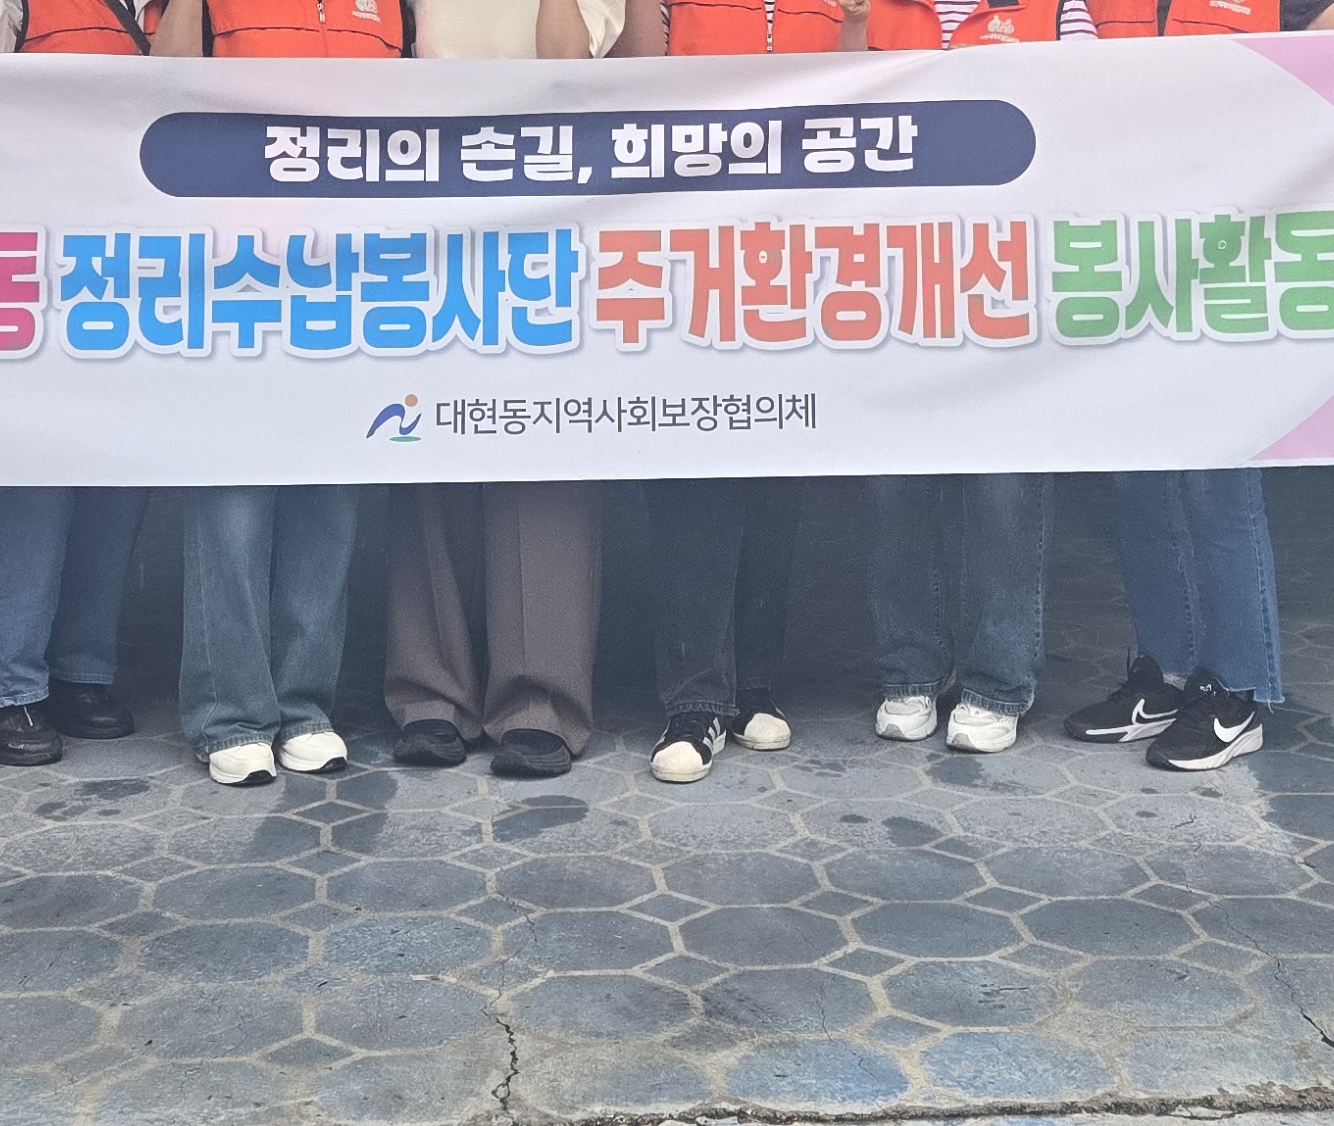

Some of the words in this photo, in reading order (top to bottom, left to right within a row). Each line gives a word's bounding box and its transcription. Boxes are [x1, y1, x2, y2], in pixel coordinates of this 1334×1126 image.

[265, 126, 440, 184] 정리의
[461, 125, 593, 187] 손길,
[610, 120, 782, 180] 희망의
[801, 114, 918, 174] 공간
[60, 227, 581, 354] 정리수납봉사단
[598, 220, 1031, 344] 주거환경개선
[436, 393, 817, 437] 대현동지역사회보장협의체
